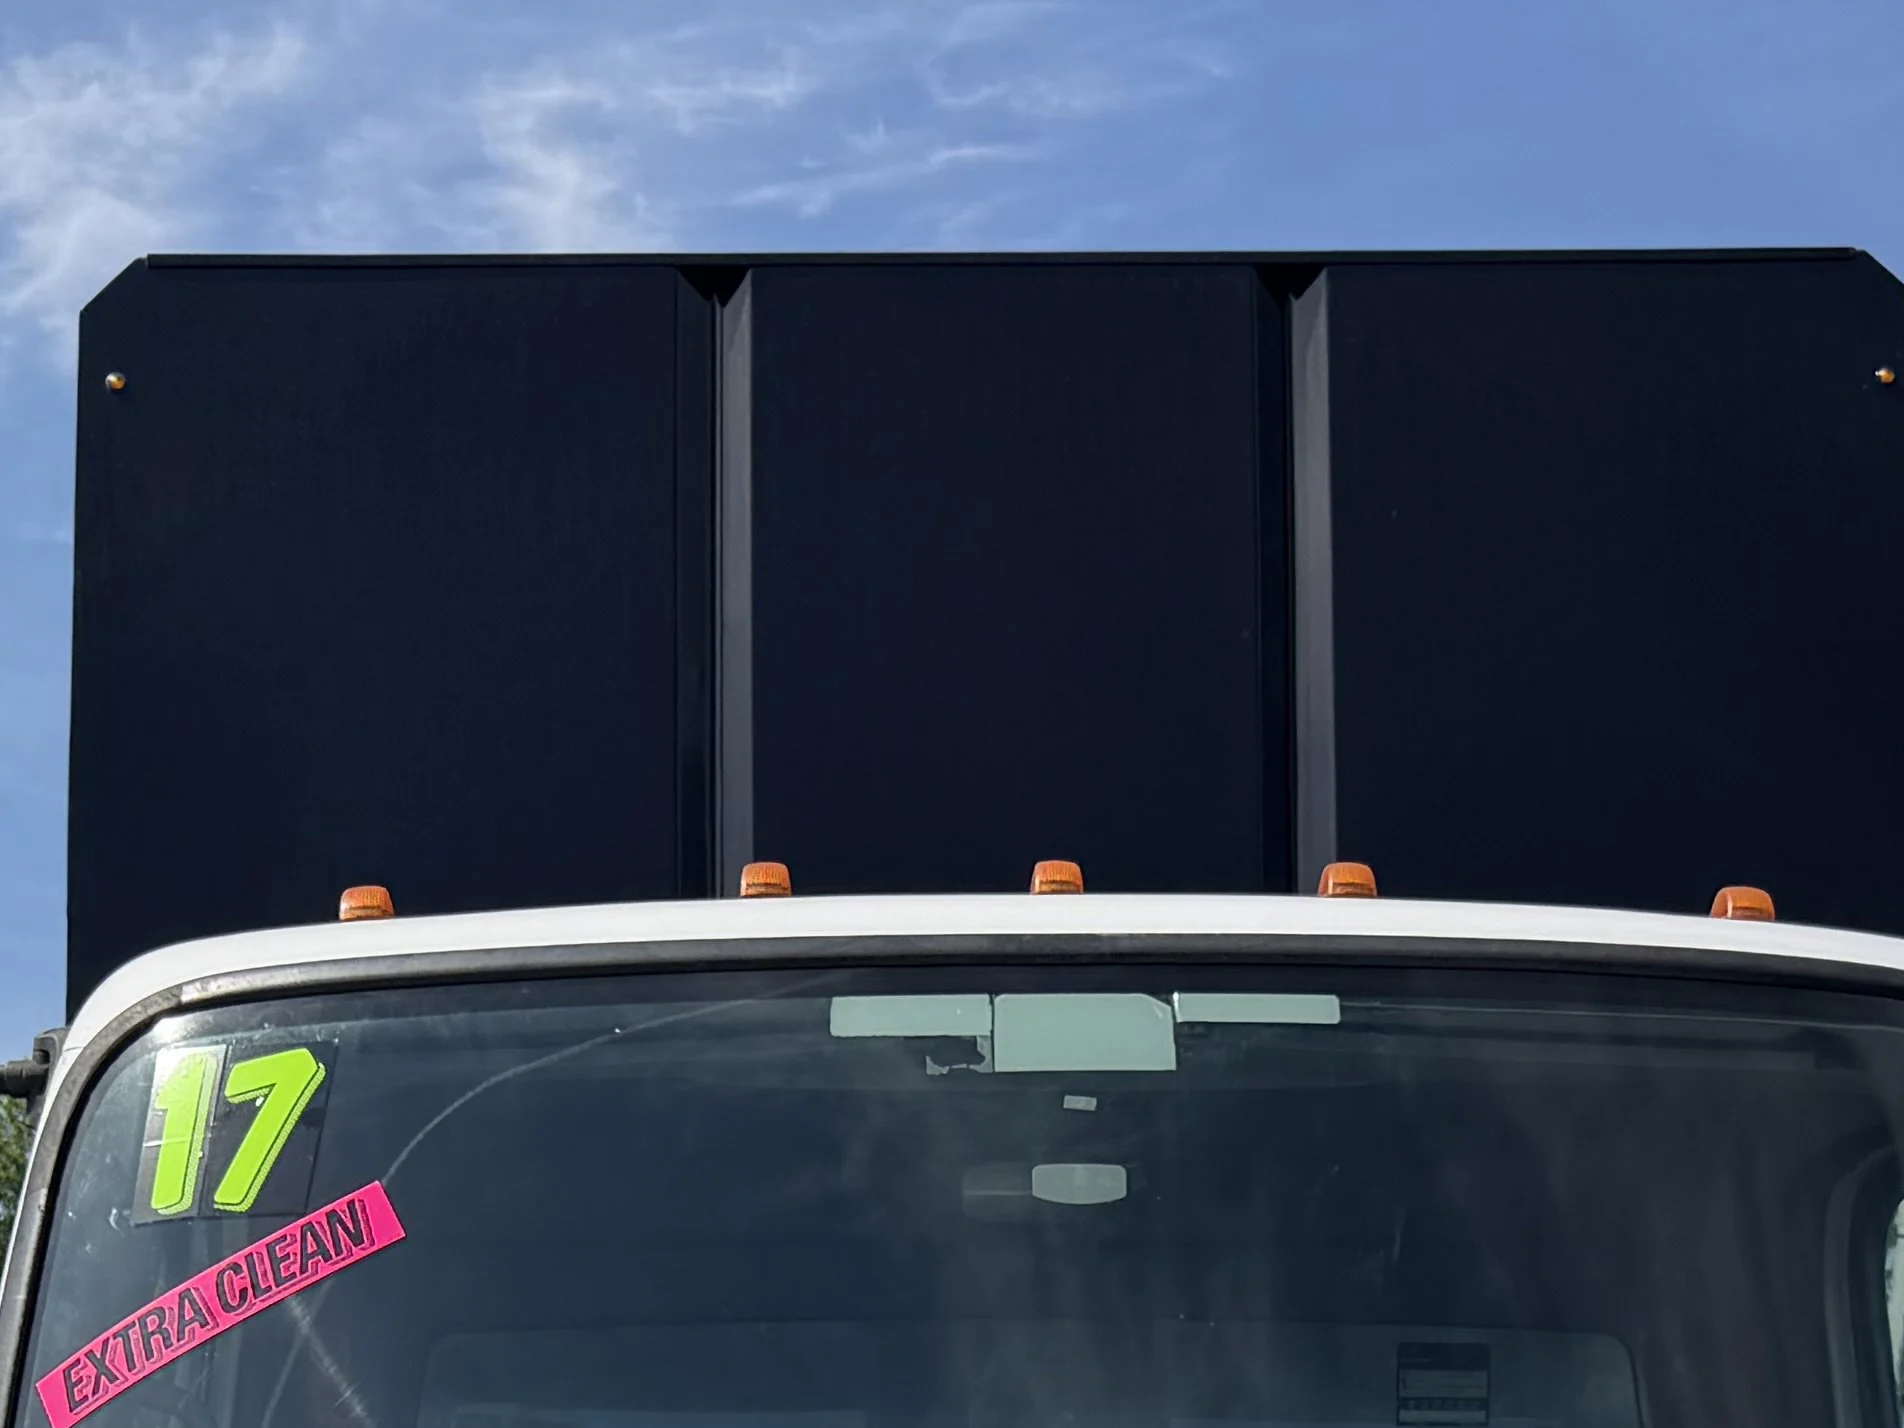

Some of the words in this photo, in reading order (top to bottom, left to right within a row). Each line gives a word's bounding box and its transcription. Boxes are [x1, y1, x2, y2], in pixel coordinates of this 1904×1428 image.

[151, 1047, 327, 1216] 17
[62, 1286, 219, 1415] EXTRA
[215, 1198, 376, 1317] CLEAN
